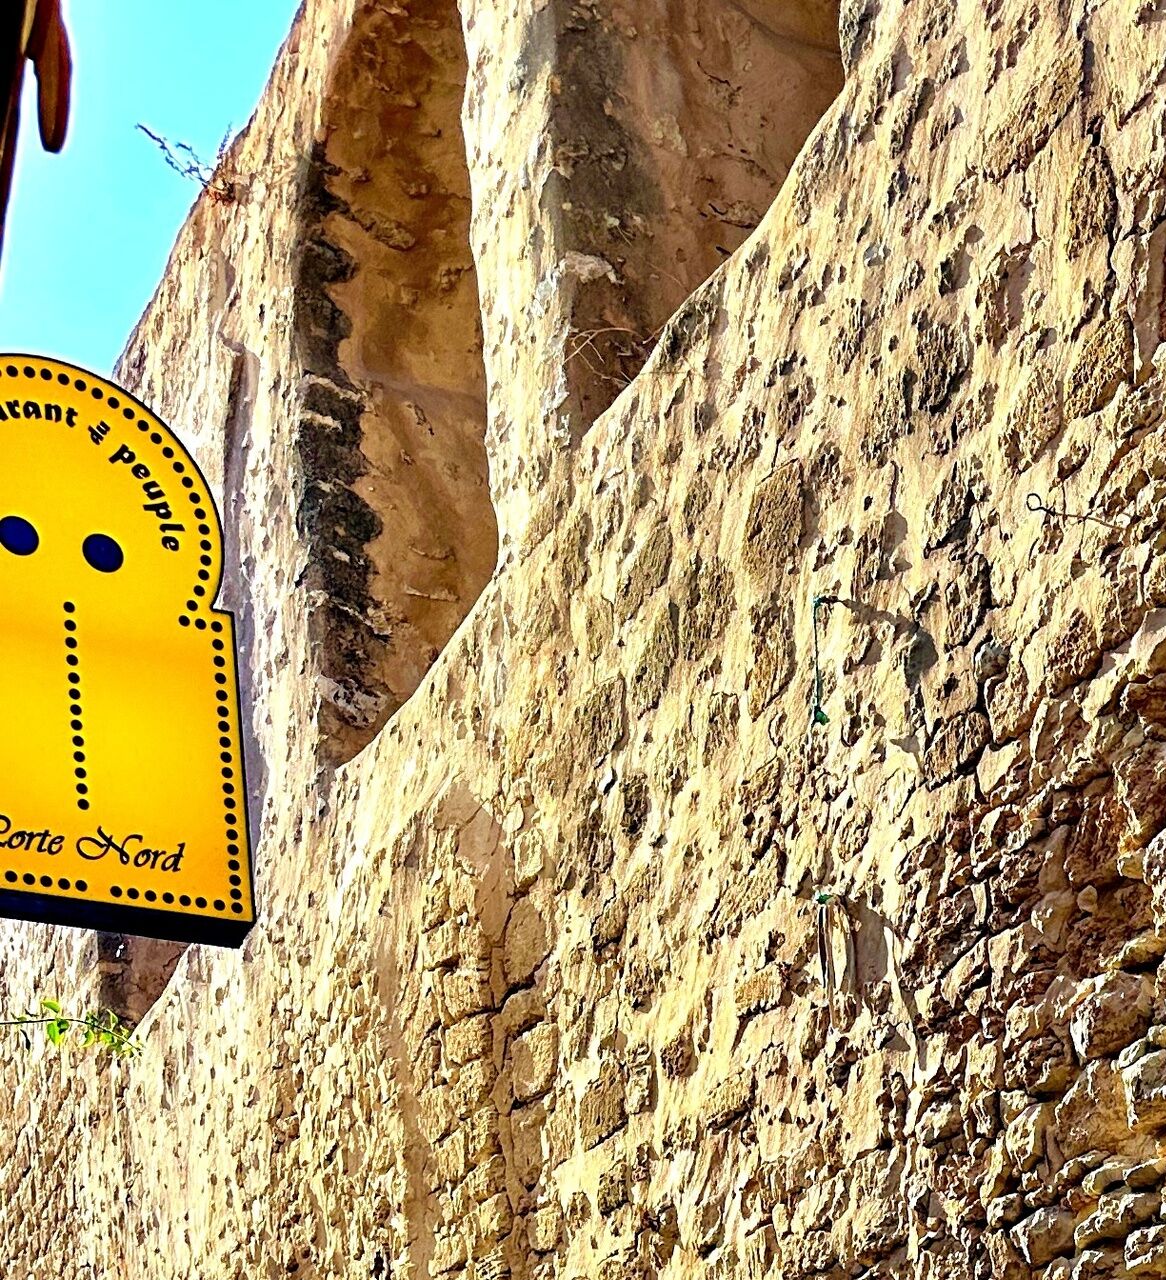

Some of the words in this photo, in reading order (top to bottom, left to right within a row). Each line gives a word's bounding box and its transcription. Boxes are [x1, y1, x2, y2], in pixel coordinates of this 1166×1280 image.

[88, 421, 111, 445] du
[109, 444, 185, 552] peuple
[76, 826, 186, 873] Nord
